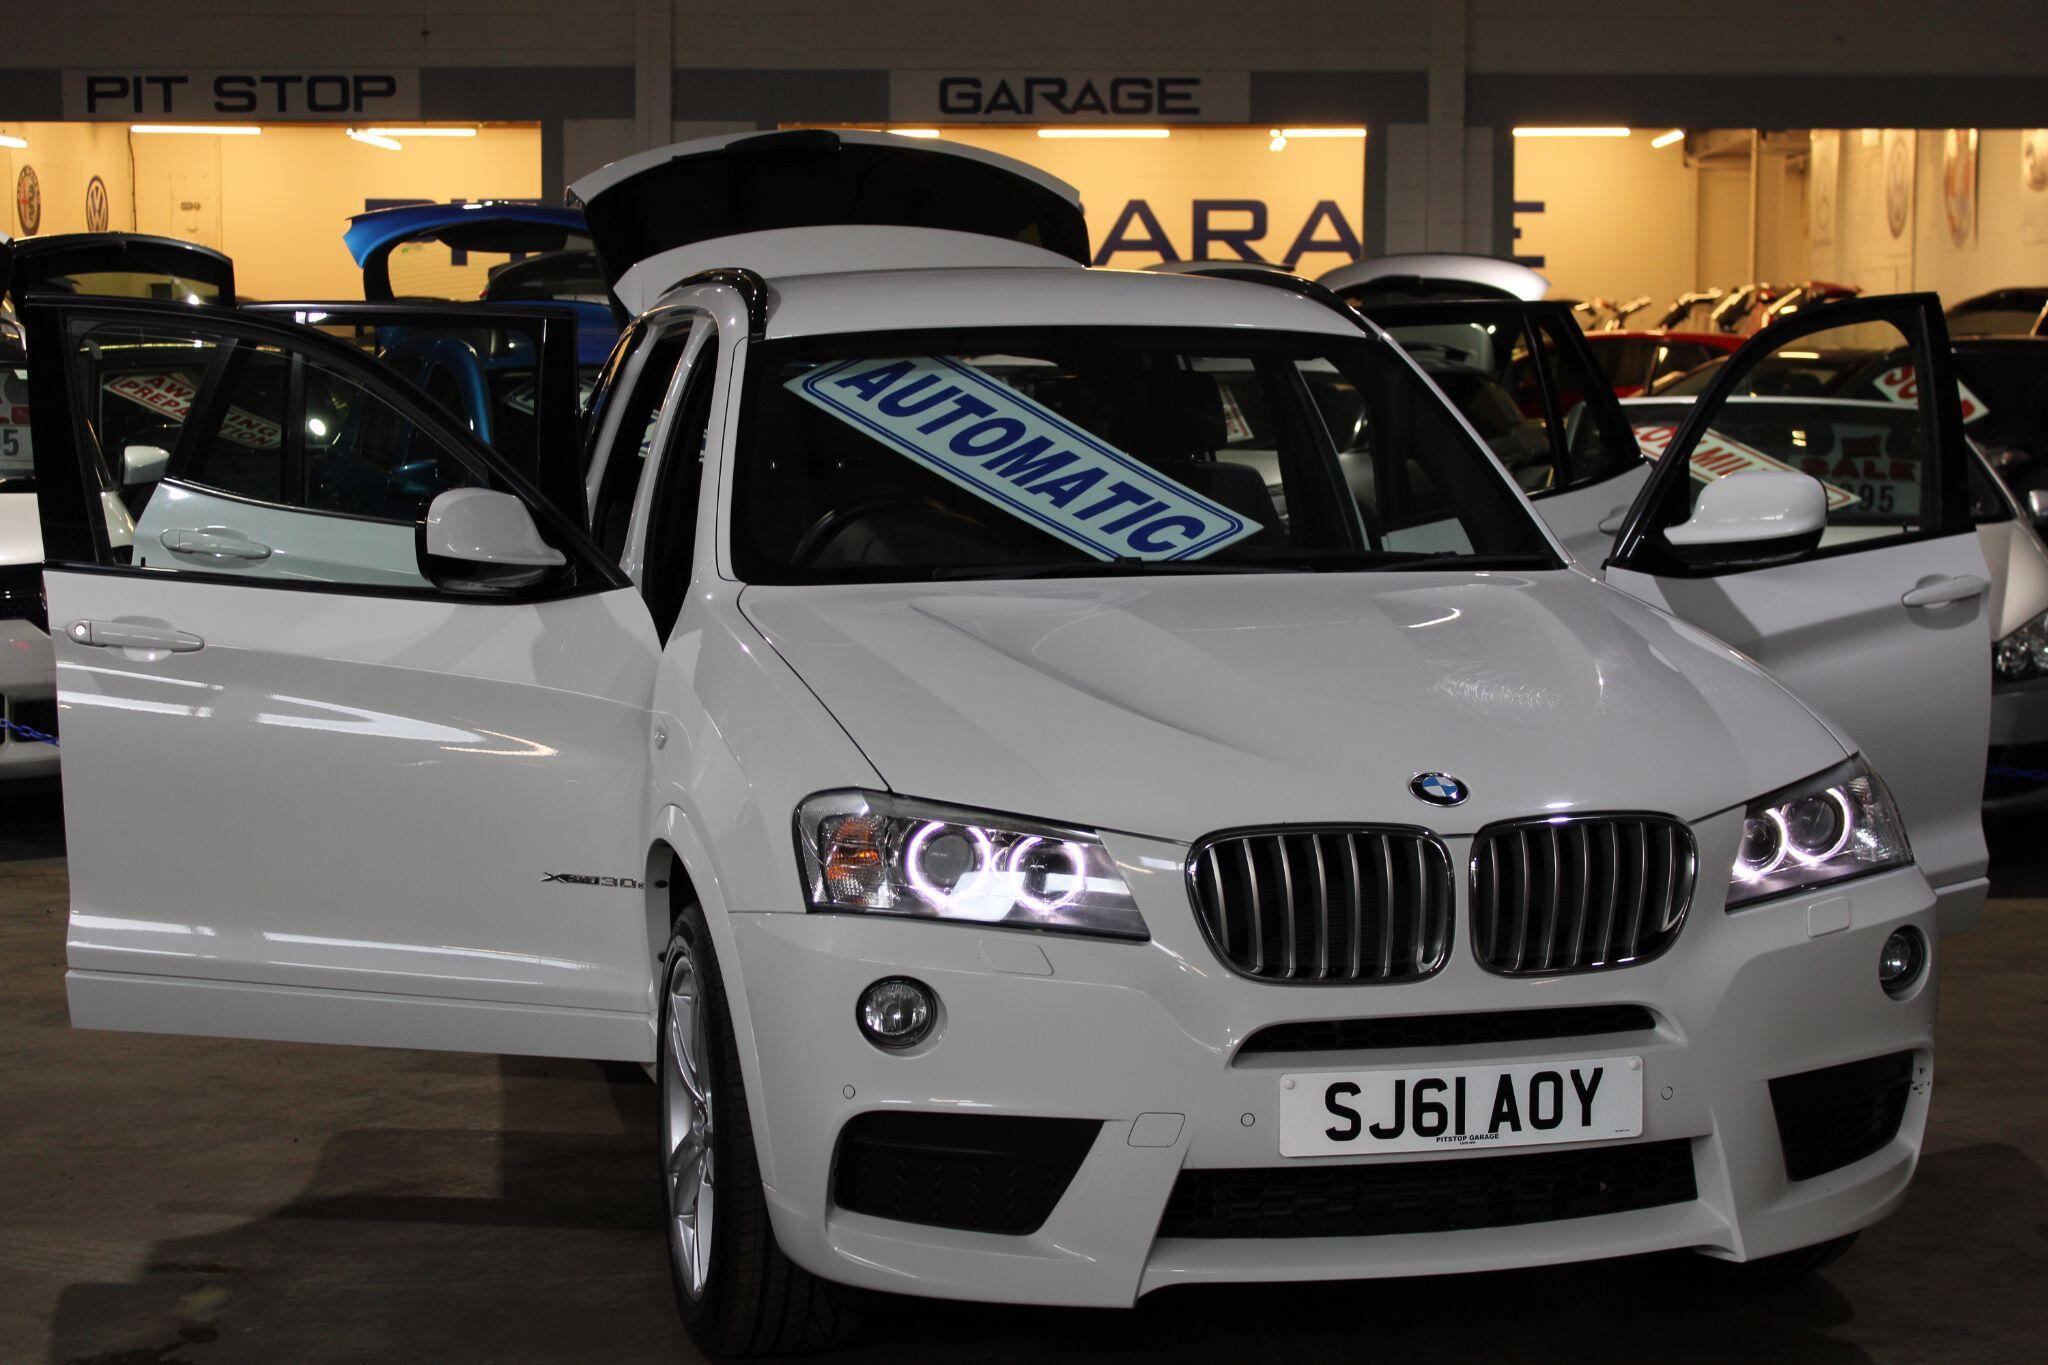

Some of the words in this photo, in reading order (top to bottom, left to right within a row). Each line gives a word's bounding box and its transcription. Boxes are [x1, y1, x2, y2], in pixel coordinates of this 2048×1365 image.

[87, 76, 189, 113] PIT
[213, 75, 397, 112] STOP
[939, 77, 1200, 114] GARAGE
[837, 359, 1206, 554] AUTOMATIC
[1325, 1076, 1467, 1142] SJ61
[1488, 1067, 1604, 1134] AOY
[1436, 1135, 1468, 1143] PITSTOP
[1469, 1133, 1500, 1141] GARAGE
